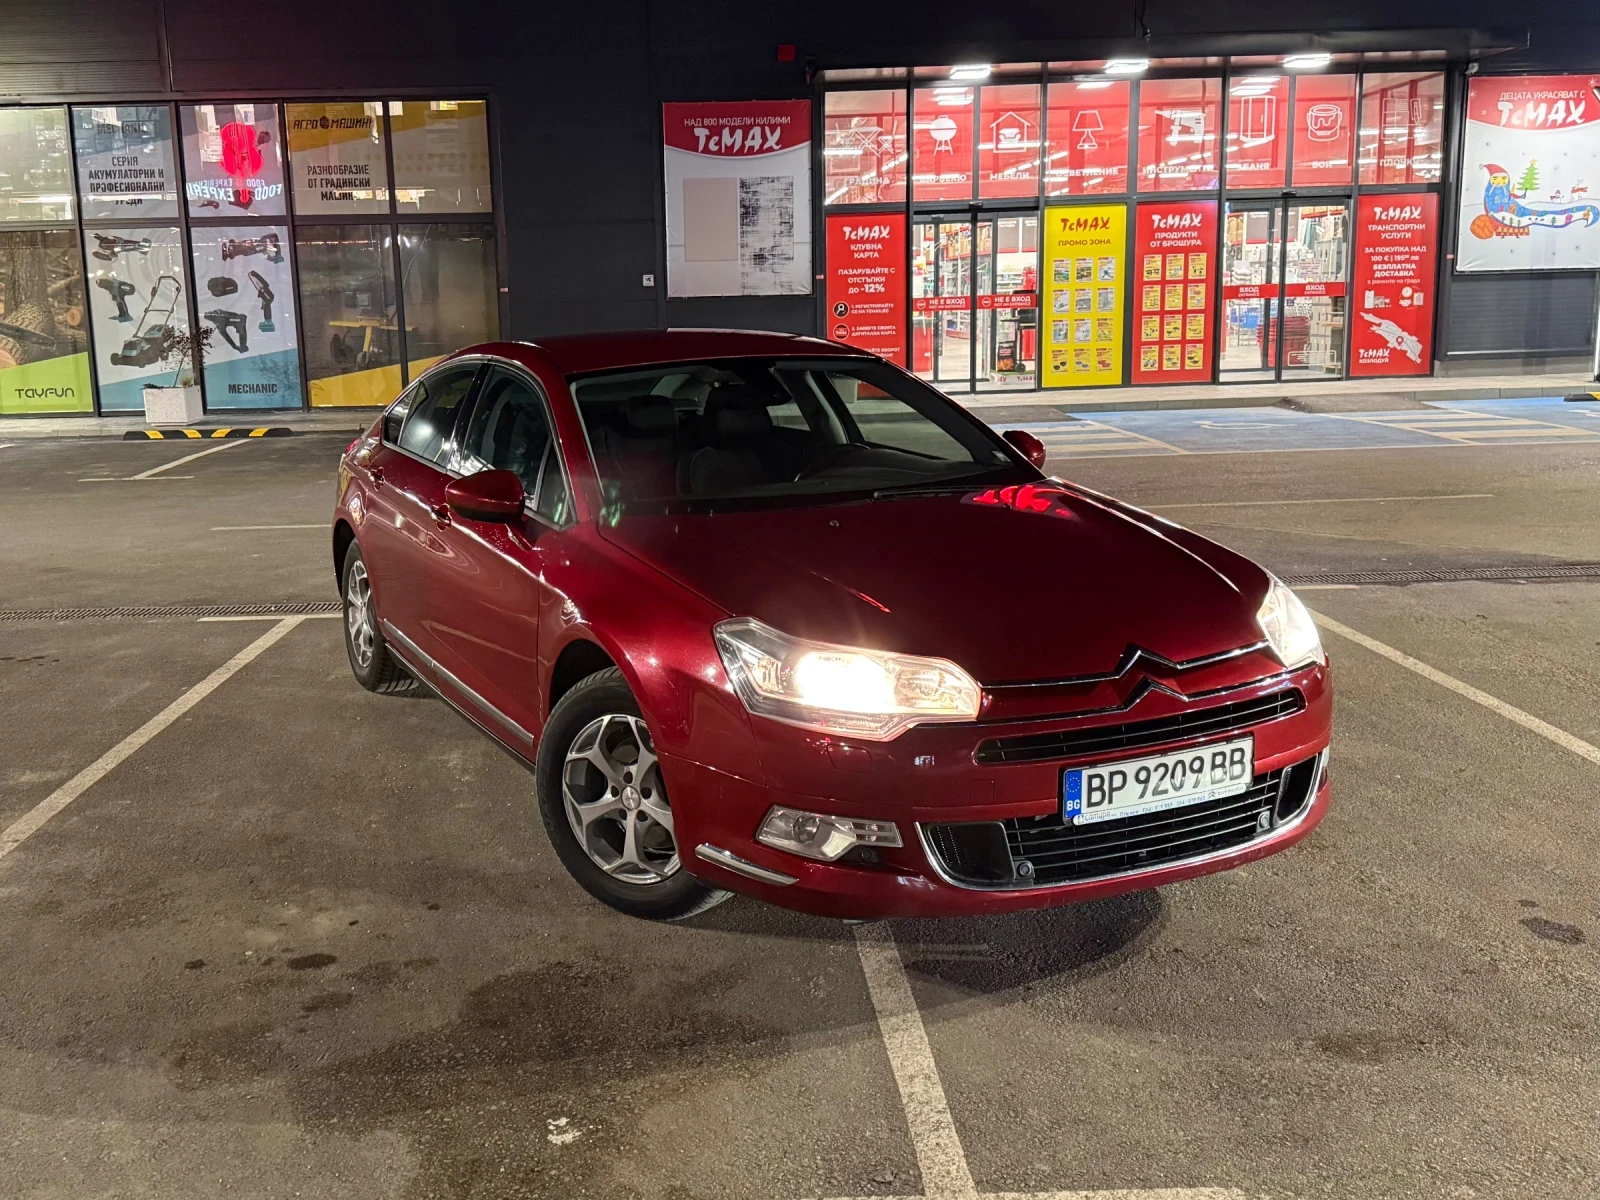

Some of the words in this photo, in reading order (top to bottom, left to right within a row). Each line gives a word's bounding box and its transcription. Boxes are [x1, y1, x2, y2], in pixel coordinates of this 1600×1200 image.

[1500, 92, 1531, 100] ДЕЦАТА
[1533, 90, 1578, 99] УКРАСЯВАТ
[1579, 90, 1585, 98] С
[293, 119, 318, 129] АГРО
[684, 118, 702, 127] НАД
[703, 118, 717, 126] 800
[719, 117, 754, 126] МОДЕЛИ
[755, 116, 790, 124] КИЛИМИ
[112, 156, 138, 166] СЕРИЯ
[88, 169, 156, 180] АКУМУЛАТОРНИ
[158, 168, 164, 179] И
[307, 164, 370, 175] РАЗНООБРАЗИЕ
[90, 181, 165, 192] ПРОФЕСИОНАЛНИ
[308, 178, 318, 188] ОТ
[320, 177, 371, 189] ГРАДИНСКИ
[1368, 223, 1426, 231] ТРАНСПОРТНИ
[1155, 231, 1198, 239] ПРОДУКТИ
[1089, 238, 1112, 246] ЗОНА
[1162, 239, 1202, 247] БРОШУРА
[838, 267, 889, 275] ПАЗАРУВАЙТЕ
[228, 383, 278, 394] MECHANIC
[1087, 769, 1127, 808] BP
[1134, 755, 1205, 800] 9209
[1210, 747, 1246, 785] BB
[1066, 799, 1081, 811] BG
